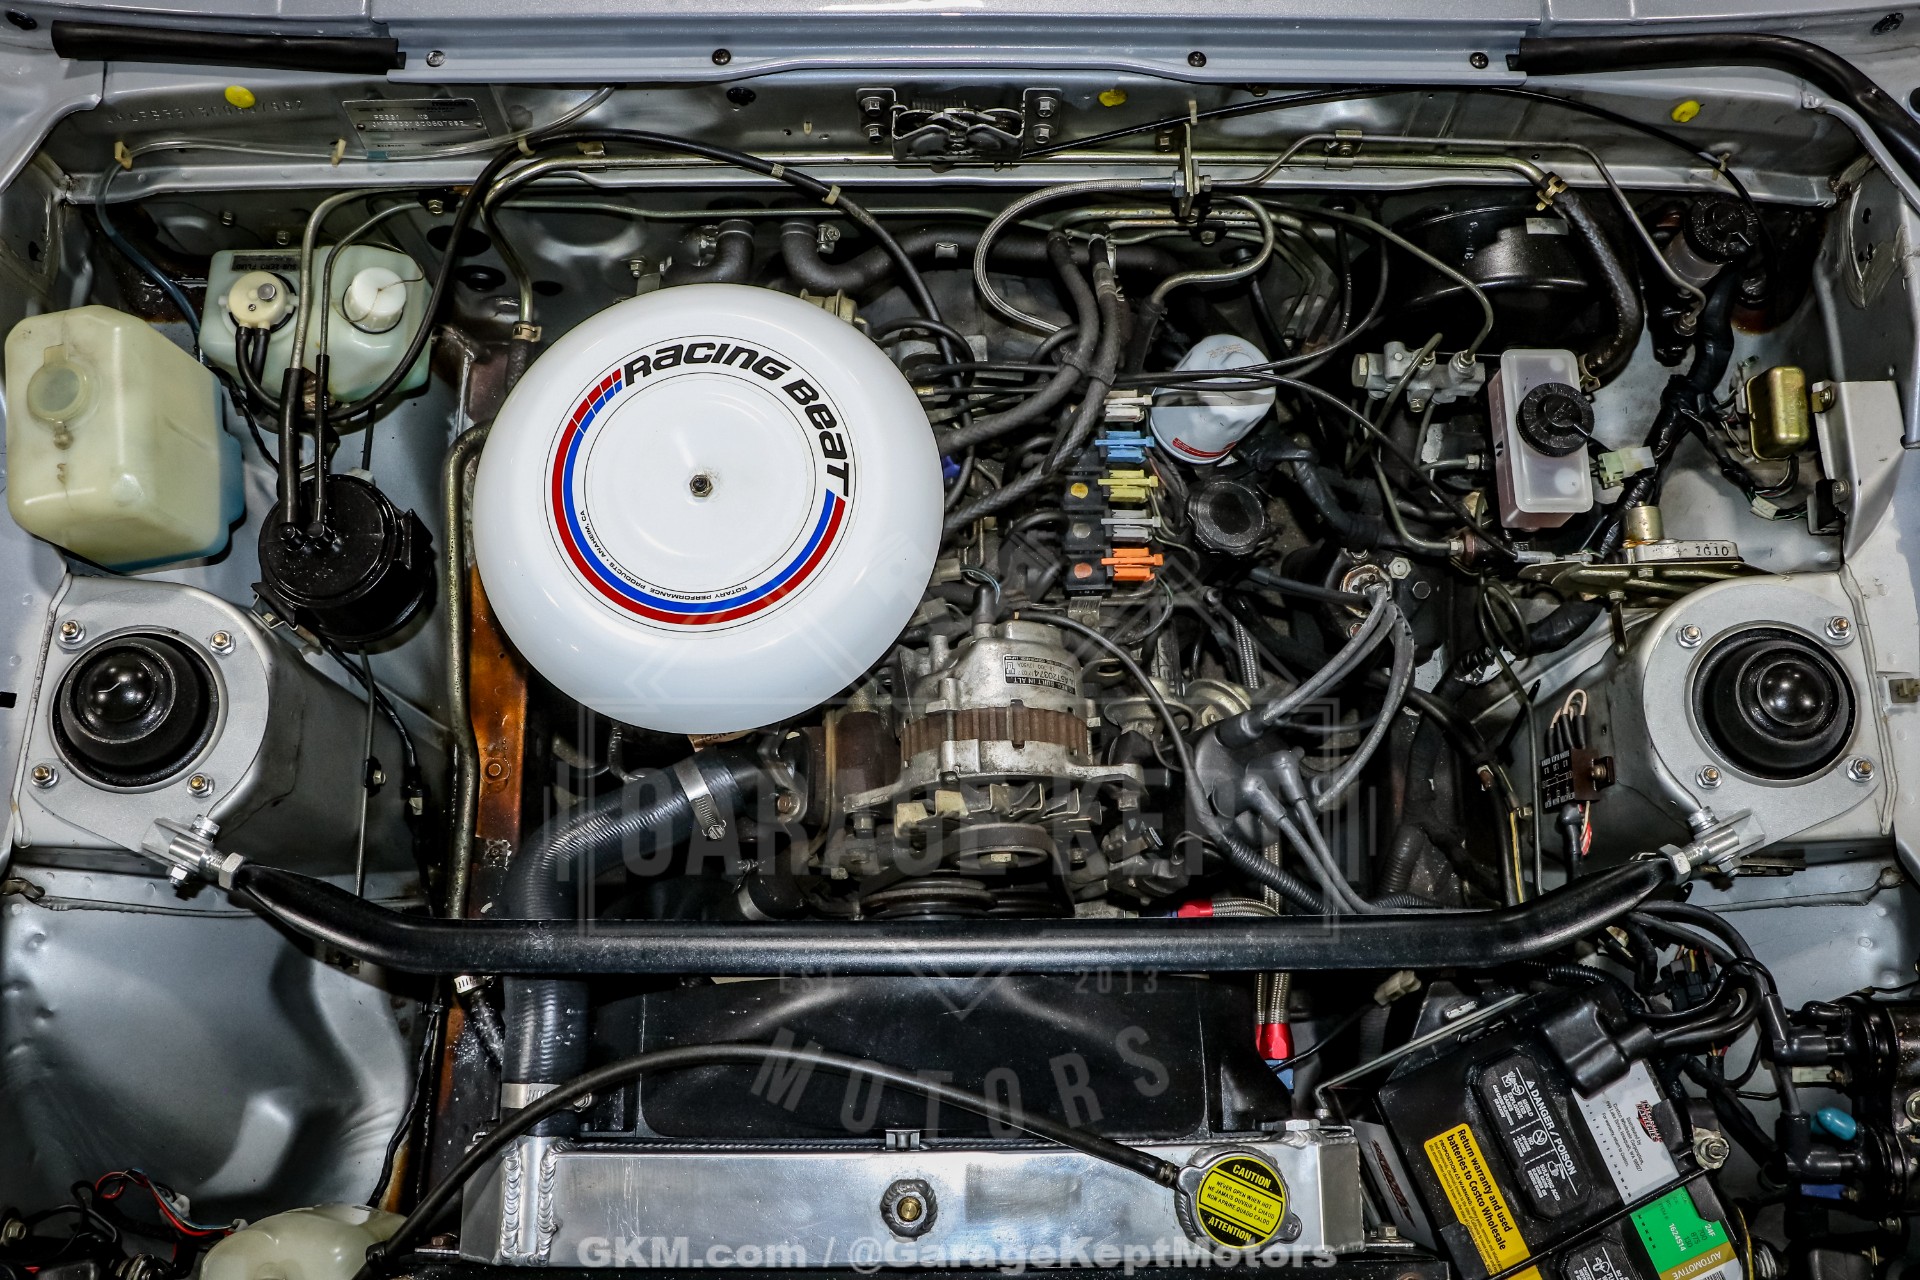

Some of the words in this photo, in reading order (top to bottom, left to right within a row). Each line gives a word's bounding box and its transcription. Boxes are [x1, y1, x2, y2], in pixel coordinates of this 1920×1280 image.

[579, 510, 586, 522] CA
[609, 561, 646, 589] PRODUCTS
[649, 587, 712, 601] PERFORMANCE
[714, 585, 748, 599] ROTARY
[1529, 1088, 1556, 1130] DANGER
[1553, 1137, 1577, 1175] POISON
[1445, 1133, 1470, 1170] batteries
[1232, 1164, 1271, 1189] CAUTION
[1456, 1128, 1476, 1157] Return
[1468, 1157, 1494, 1196] warranty
[1488, 1193, 1502, 1211] and
[1496, 1210, 1512, 1232] used
[1463, 1169, 1474, 1180] to
[1216, 1181, 1232, 1192] NEVER
[1233, 1189, 1246, 1198] OPEN
[1247, 1194, 1261, 1204] WHEN
[1261, 1201, 1272, 1210] HOT
[1216, 1189, 1233, 1200] JAMAIS
[1258, 1207, 1275, 1219] CHAUD
[1467, 1179, 1487, 1207] Costco
[1208, 1216, 1252, 1242] ATTENTION
[1254, 1214, 1270, 1225] CALDO
[1480, 1206, 1508, 1250] Wholesale
[1704, 1223, 1715, 1238] 24F
[1683, 1235, 1693, 1248] 130
[1689, 1230, 1700, 1244] 875
[1672, 1251, 1721, 1280] AUTOMOTIVE
